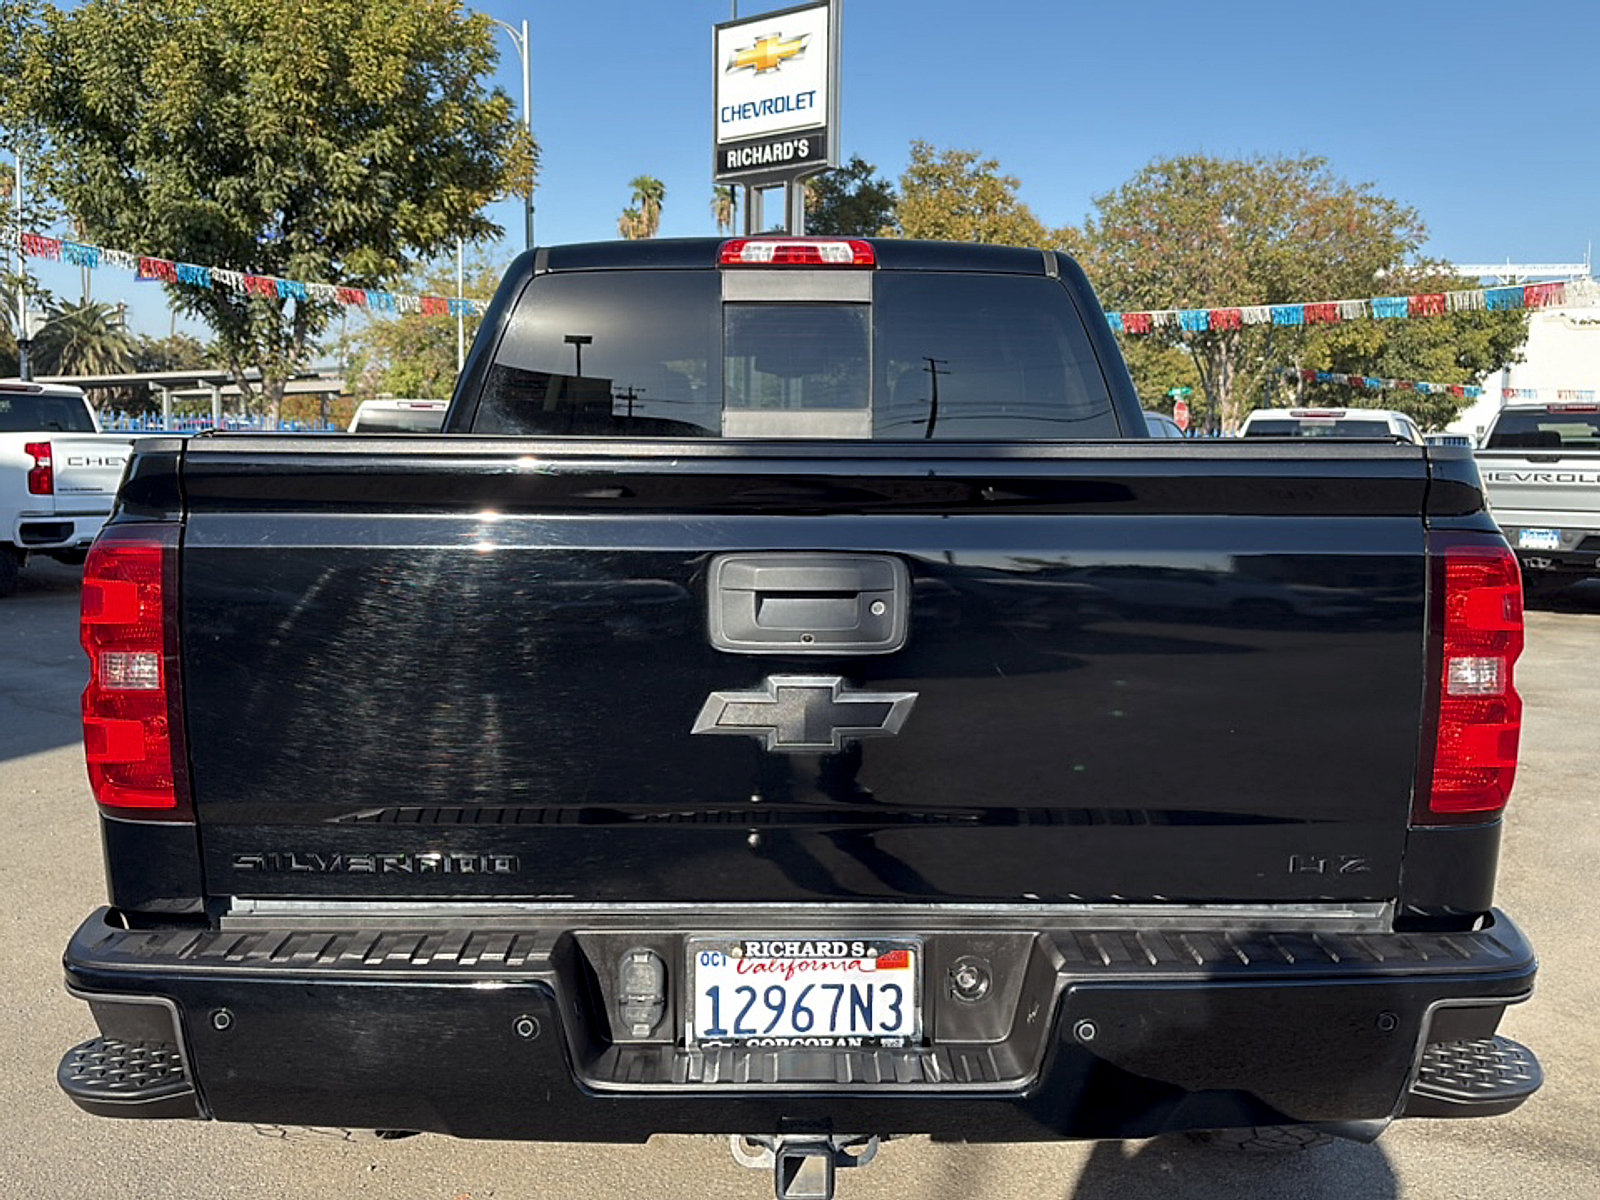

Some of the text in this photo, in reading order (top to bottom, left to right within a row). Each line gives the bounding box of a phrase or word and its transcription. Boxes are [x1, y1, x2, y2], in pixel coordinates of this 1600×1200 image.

[721, 90, 817, 123] CHEVROLET
[726, 138, 809, 168] RICHARD'S
[232, 853, 520, 874] SILVERADO
[700, 953, 727, 967] OCT
[736, 957, 877, 981] California
[704, 983, 903, 1036] 12967N3
